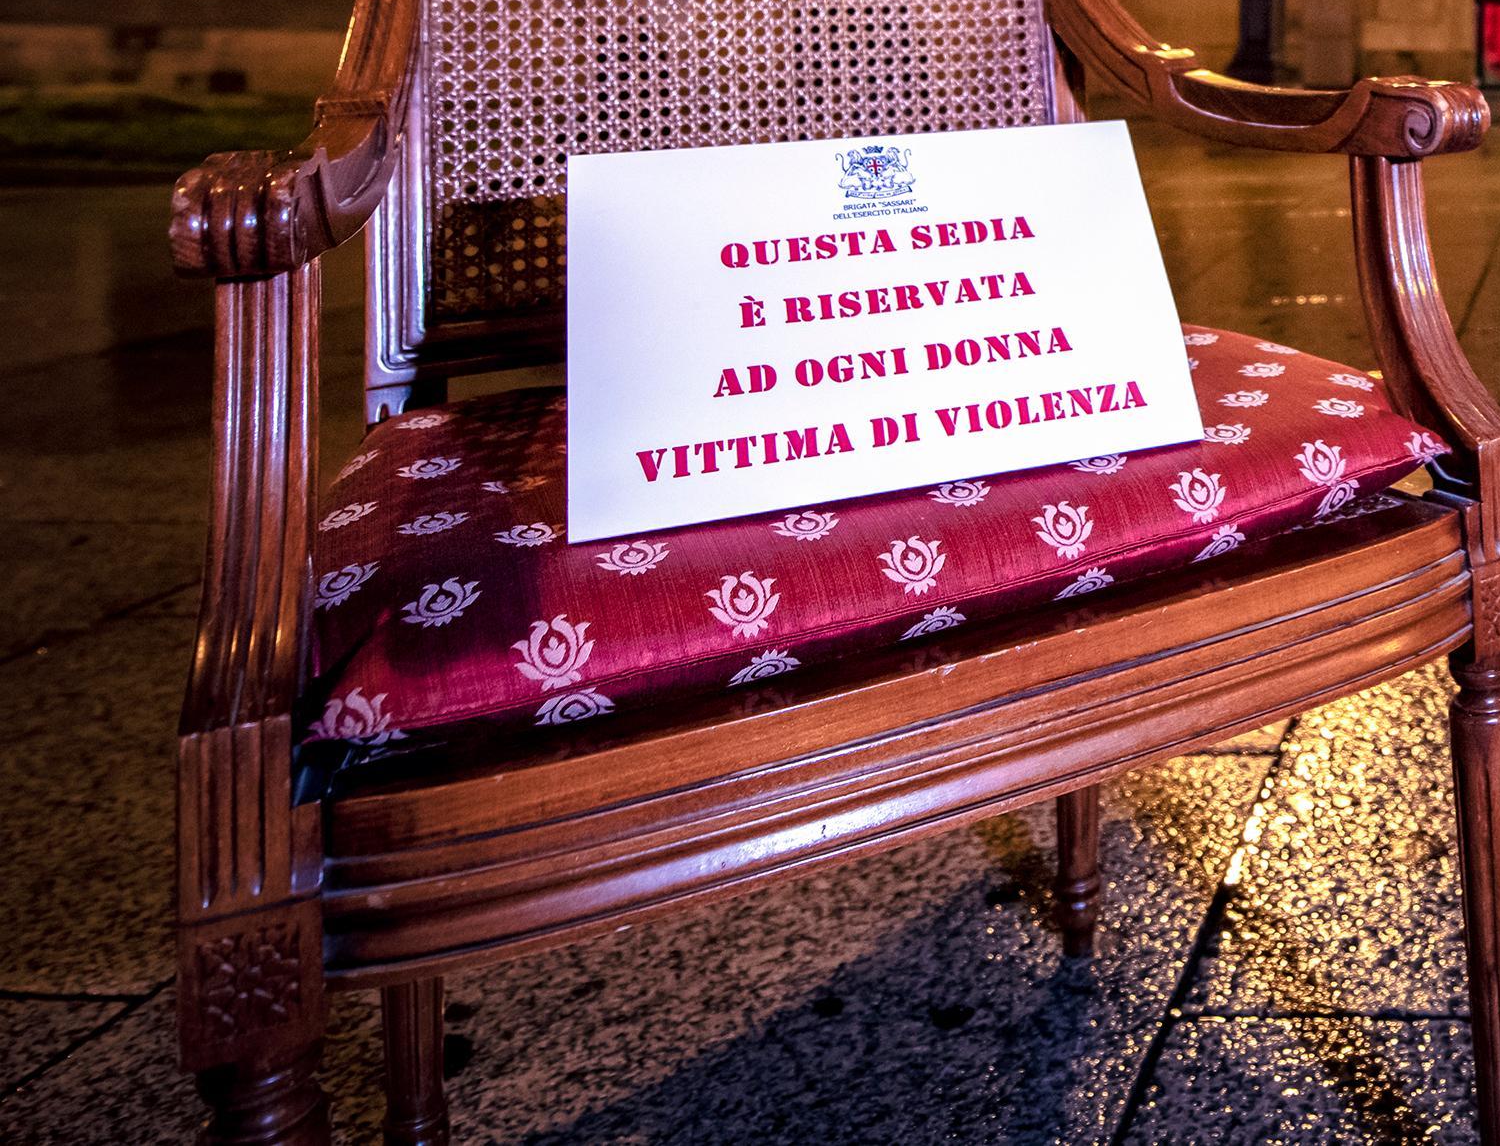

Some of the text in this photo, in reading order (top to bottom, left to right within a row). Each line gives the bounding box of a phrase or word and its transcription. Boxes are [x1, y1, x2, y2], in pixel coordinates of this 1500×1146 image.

[832, 205, 929, 220] DELL'ESERCITO ITALIANO
[843, 198, 917, 211] BRIGATA "SASSARI"
[720, 216, 1035, 269] QUESTA SEDIA
[740, 271, 1035, 329] È RISERVATA
[714, 327, 1073, 398] AD OGNI DONNA
[636, 380, 1147, 483] VITTIMA DI VIOLENZA
